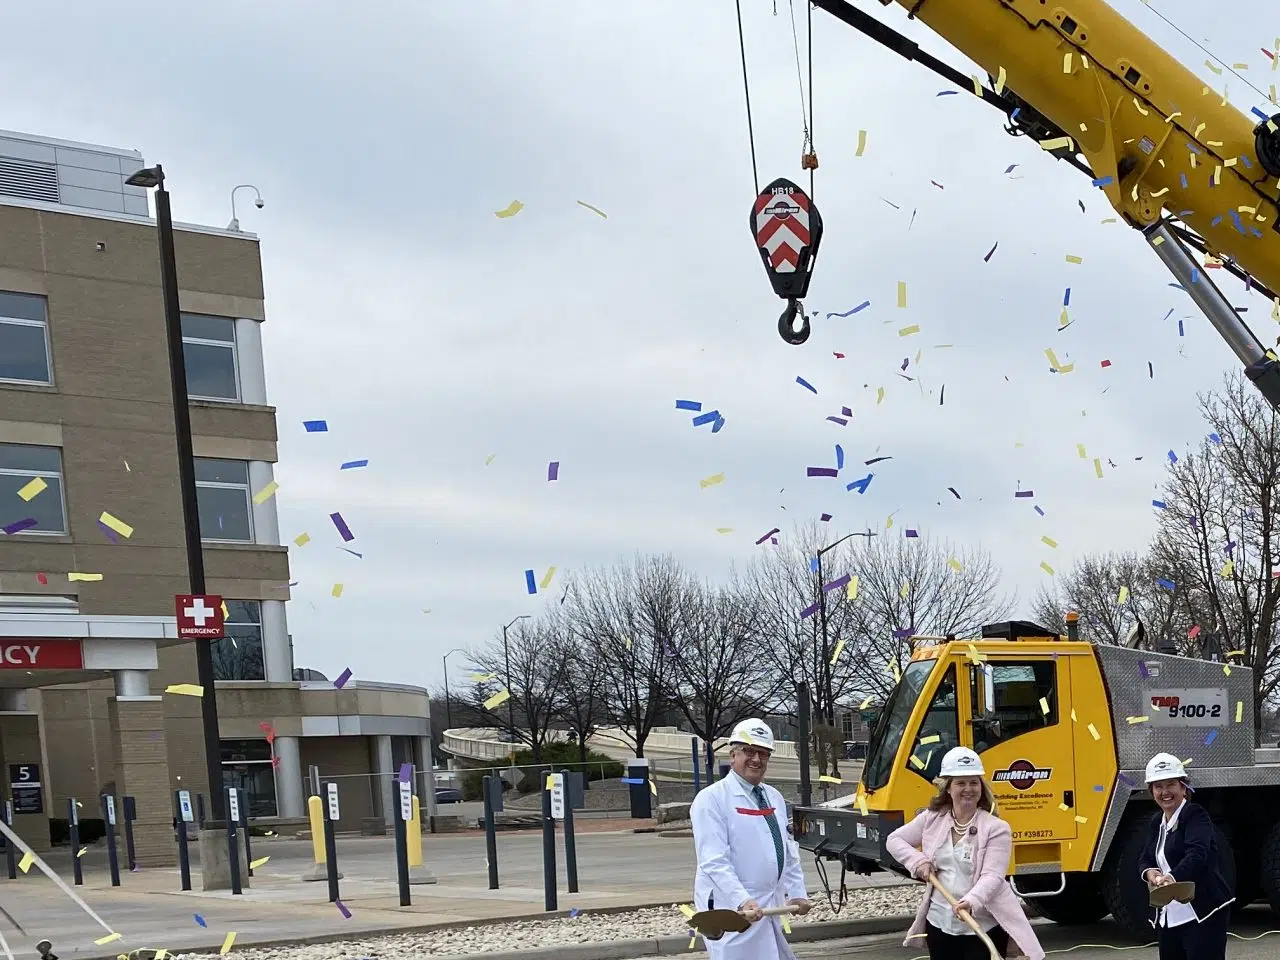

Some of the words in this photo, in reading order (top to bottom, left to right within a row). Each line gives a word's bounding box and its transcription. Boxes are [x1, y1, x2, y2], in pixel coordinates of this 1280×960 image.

[0, 645, 40, 664] CY
[1168, 704, 1221, 718] 9100-2
[19, 766, 30, 781] 5
[1009, 770, 1049, 780] Miron
